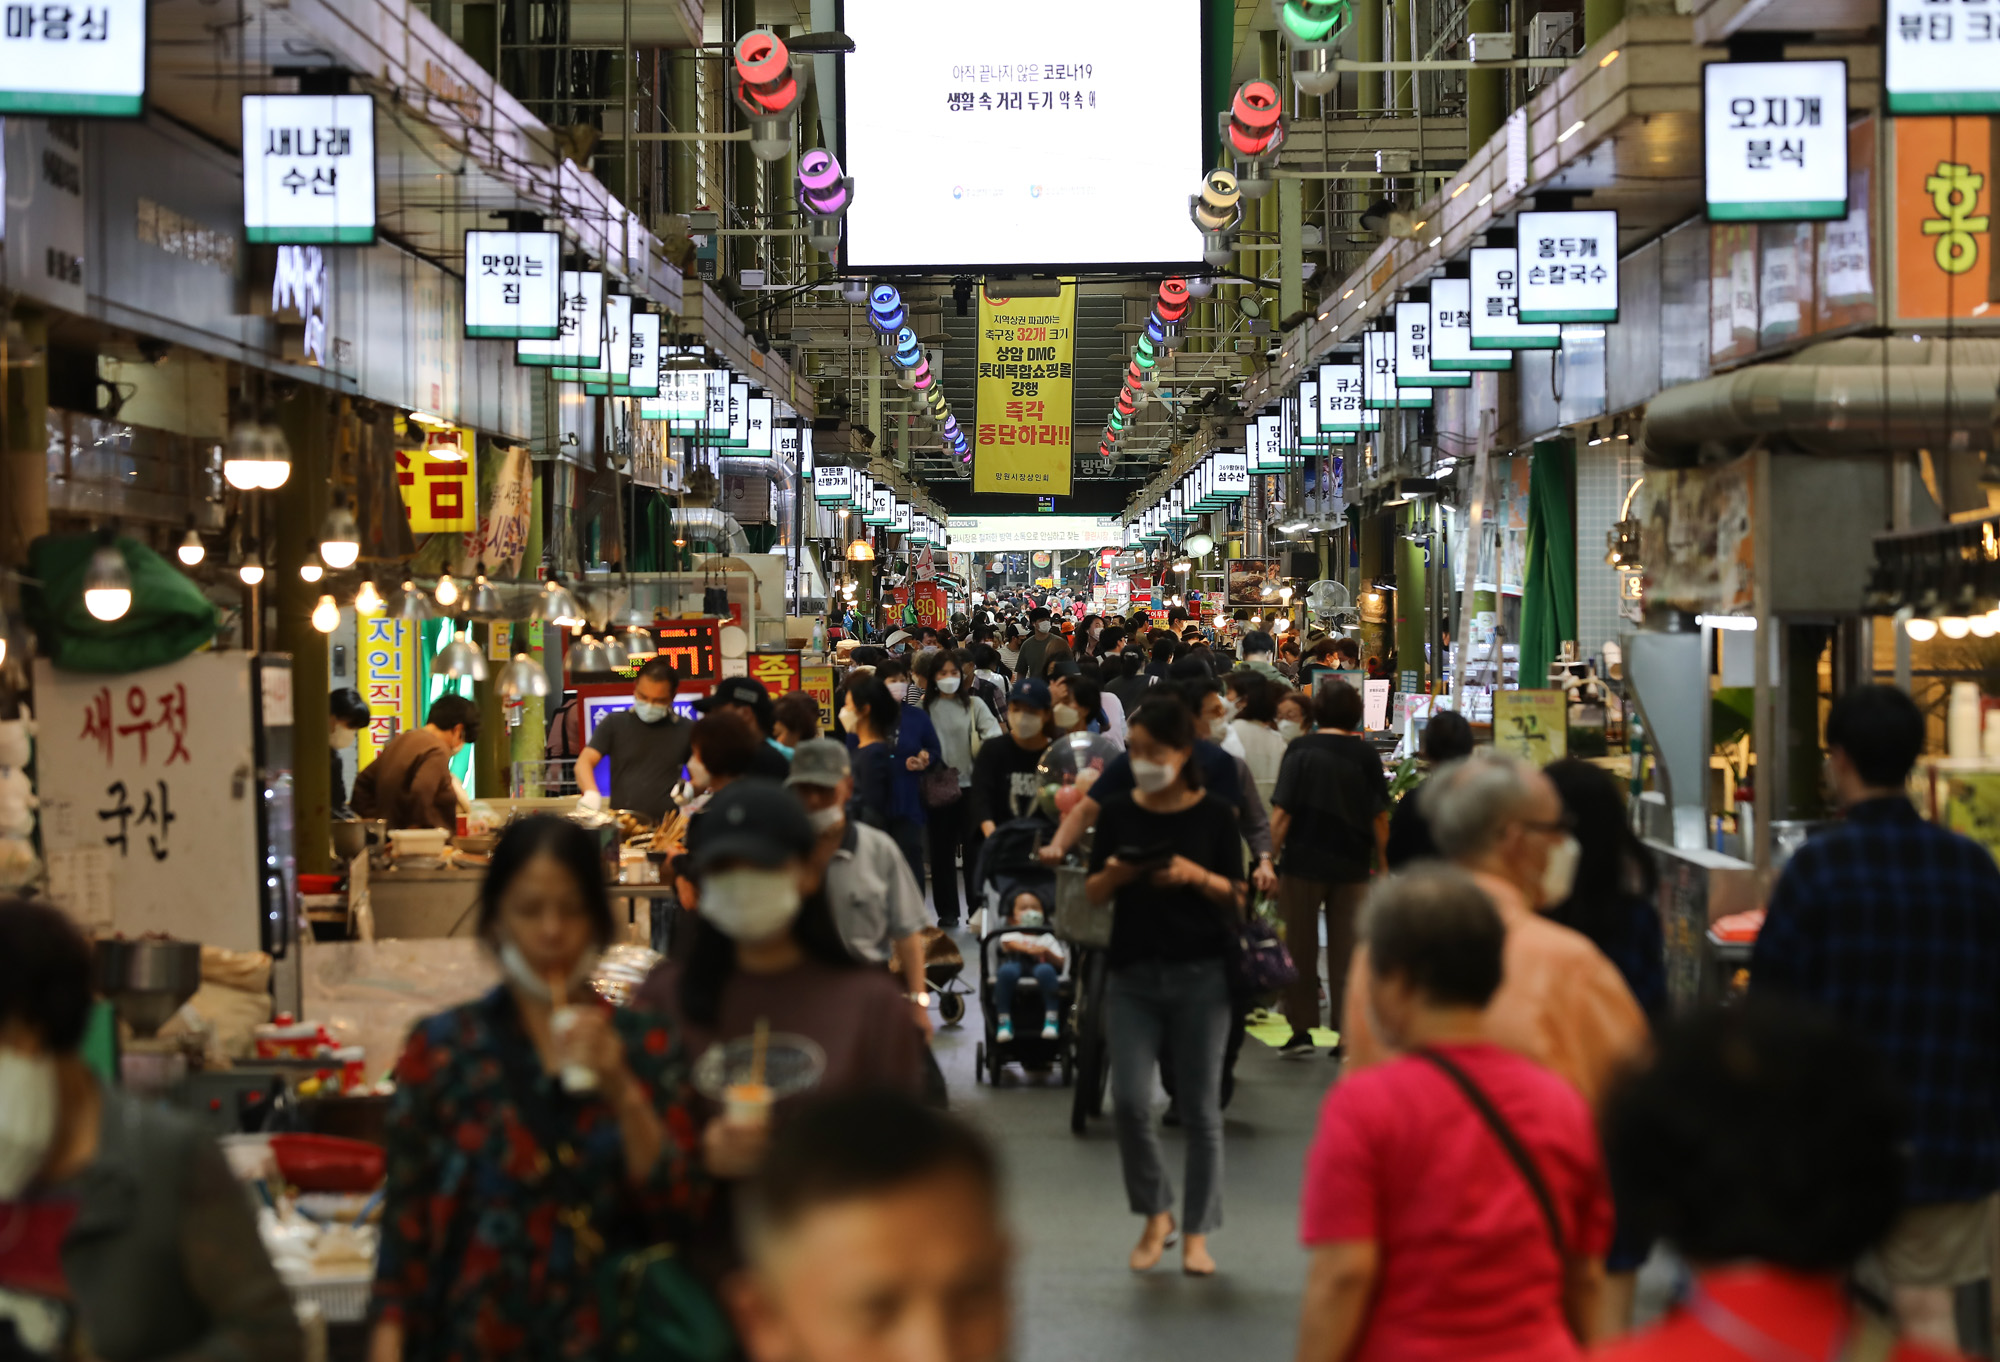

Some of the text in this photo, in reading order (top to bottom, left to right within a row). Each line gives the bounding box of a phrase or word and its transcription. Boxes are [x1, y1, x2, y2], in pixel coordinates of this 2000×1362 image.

[6, 5, 109, 41] 마당쇠
[953, 63, 1093, 82] 아직 끝나지 않은 코로나19
[947, 92, 975, 111] 생활
[979, 92, 992, 110] 속
[266, 127, 352, 156] 새나래
[1746, 139, 1805, 170] 분식
[282, 167, 337, 196] 수산
[1922, 161, 1990, 275] 홍
[482, 255, 543, 277] 맛있는
[1528, 265, 1608, 284] 손칼국수
[502, 283, 521, 305] 집
[993, 314, 1060, 325] 지역상권 파괴하는
[985, 326, 1068, 341] 축구장 32개 크기
[996, 346, 1056, 362] 상암 DMC
[979, 362, 1072, 379] 롯데복합쇼핑몰
[1011, 381, 1039, 397] 강행
[1005, 400, 1045, 422] 즉각
[978, 423, 1070, 446] 중단하라!!
[818, 477, 848, 486] 신발가게
[995, 472, 1050, 482] 망원시장상인회
[1218, 472, 1245, 482] 섬수산
[915, 598, 936, 616] 80
[79, 682, 191, 767] 새우젓
[97, 779, 177, 862] 국산
